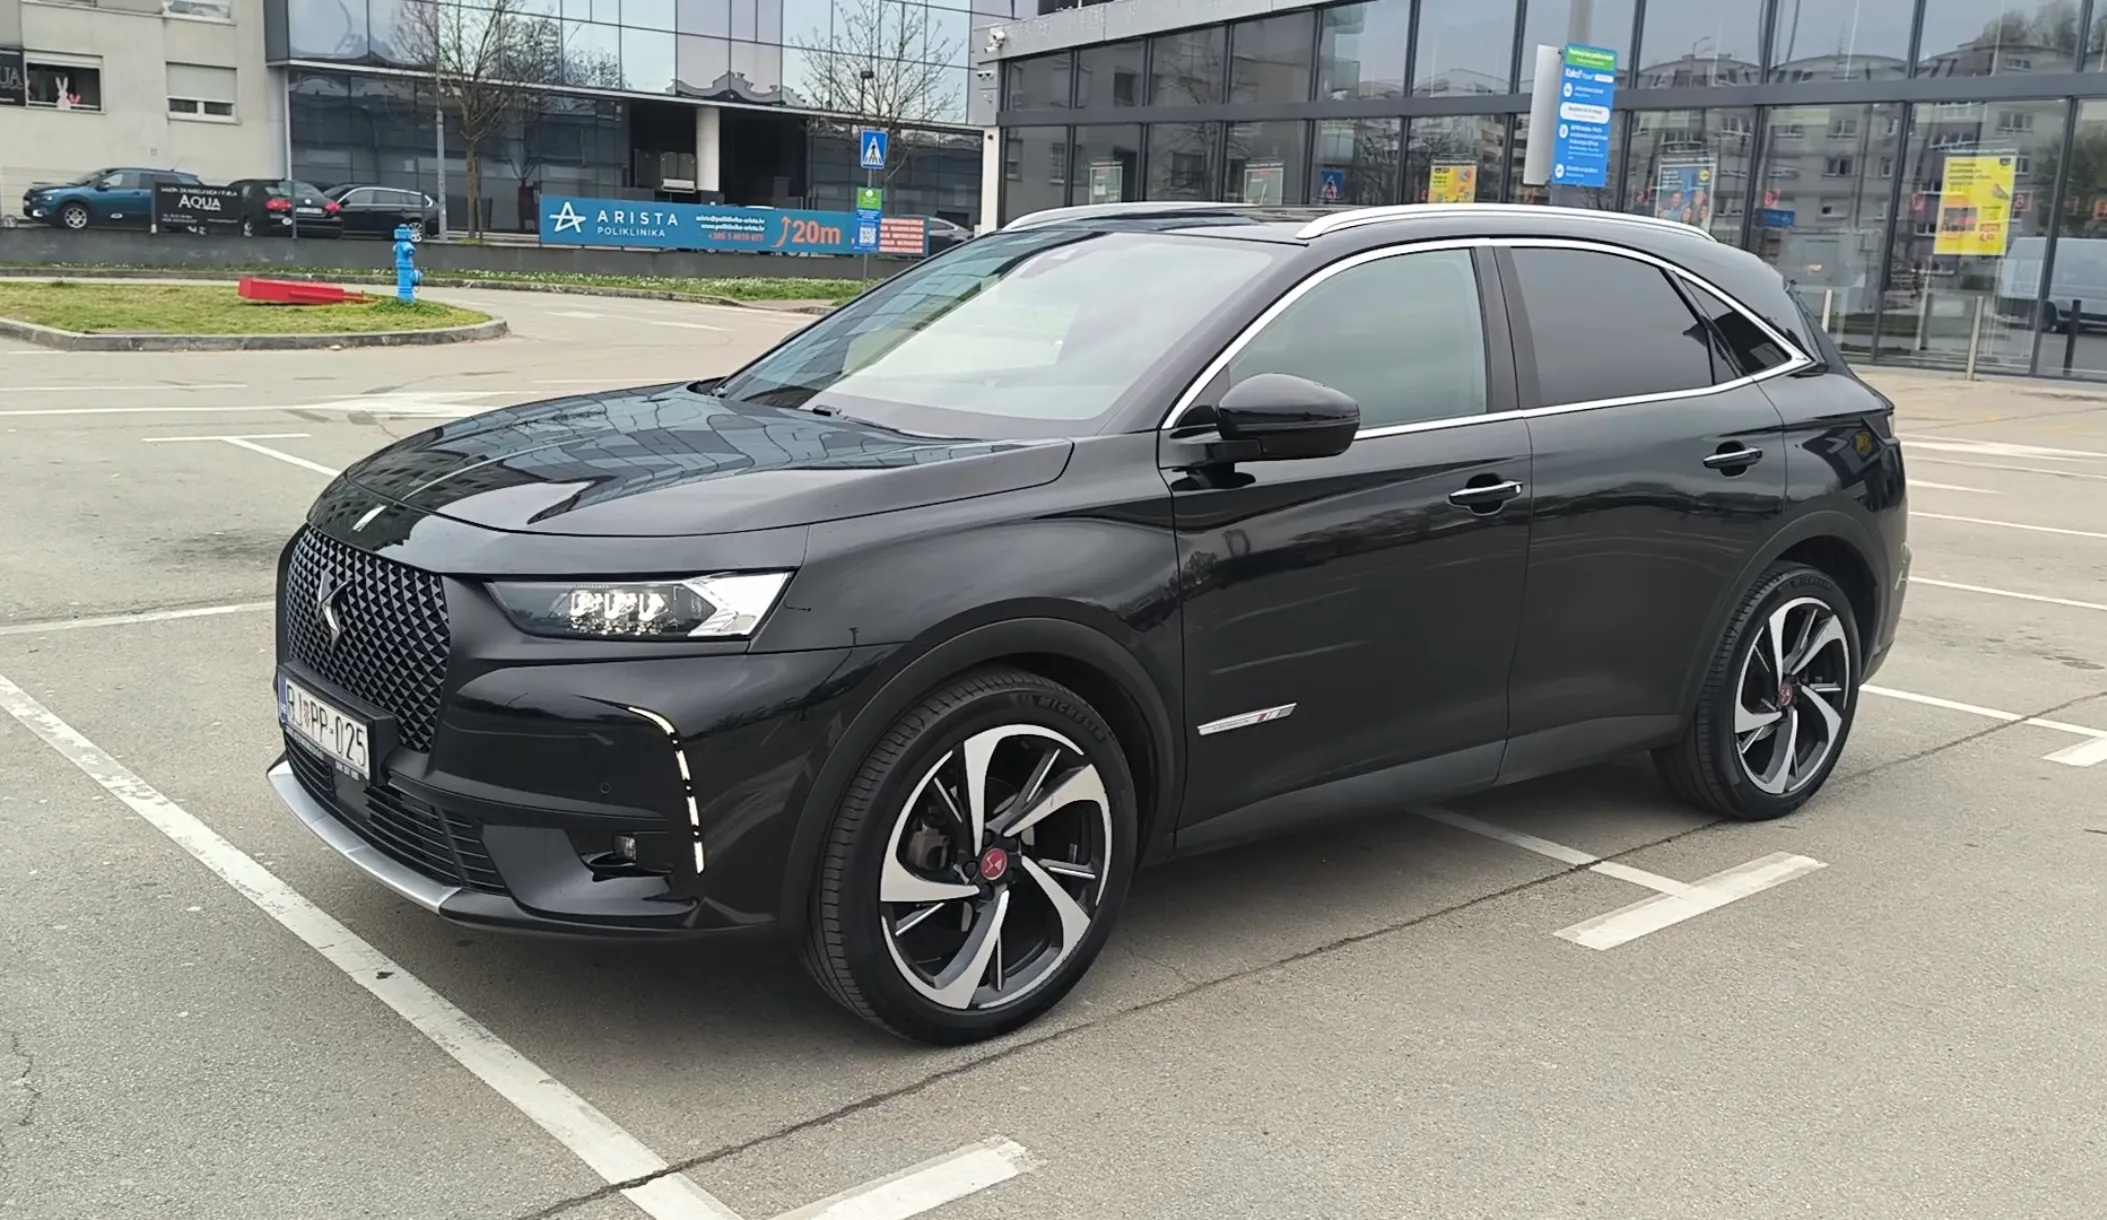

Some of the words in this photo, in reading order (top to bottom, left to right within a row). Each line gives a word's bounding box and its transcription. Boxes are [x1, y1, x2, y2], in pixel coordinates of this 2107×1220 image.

[178, 194, 221, 211] AQUA
[597, 209, 679, 227] ARISTA
[597, 226, 666, 237] POLIKLINIKA
[791, 219, 842, 245] 20m
[1038, 696, 1104, 740] MICHELIN
